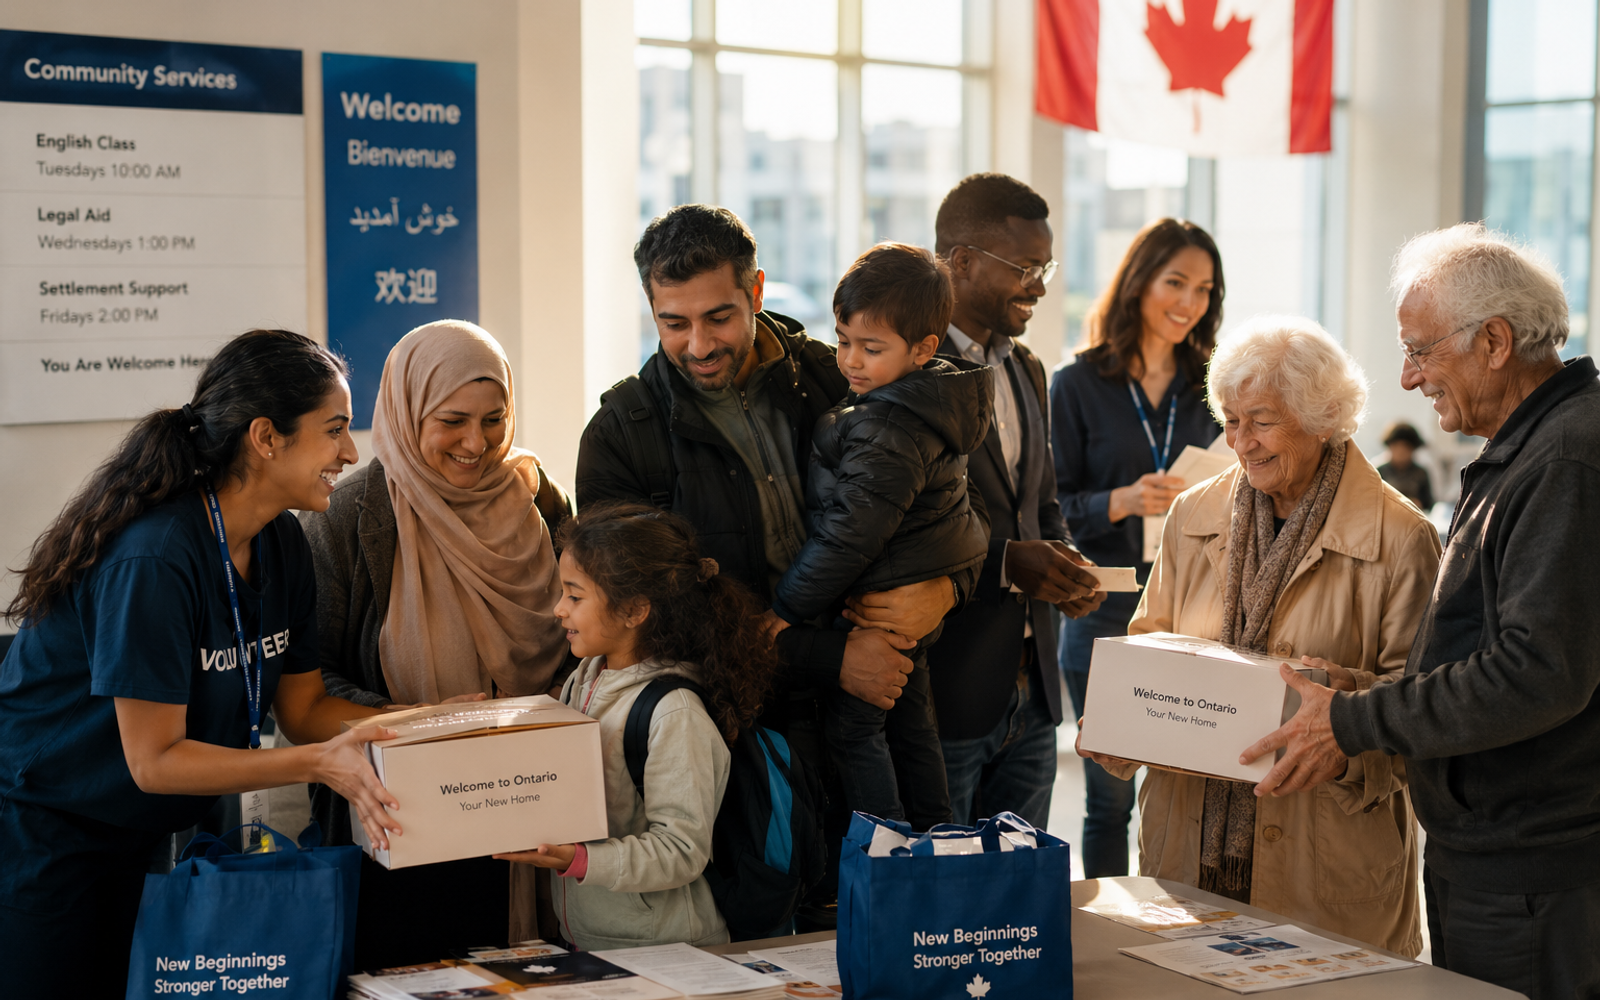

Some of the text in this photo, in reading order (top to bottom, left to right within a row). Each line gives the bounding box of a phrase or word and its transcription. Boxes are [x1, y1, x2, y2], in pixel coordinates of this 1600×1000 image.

[24, 57, 238, 90] Community Services
[340, 91, 461, 125] Welcome
[36, 133, 136, 153] English Class
[347, 139, 457, 170] Bienvenue
[36, 160, 181, 181] Tuesdays 10:00 AM
[37, 207, 111, 225] Legal Aid
[405, 203, 459, 235] خوش
[37, 234, 195, 254] Wednesdays 1:00 PM
[39, 280, 188, 298] Settlement Support
[375, 268, 438, 304] 欢迎
[40, 307, 158, 327] Fridays 2:00 PM
[40, 358, 70, 373] You
[75, 358, 103, 371] Are
[106, 356, 176, 371] Welcome
[1133, 686, 1237, 715] Welcome to Ontario
[1145, 707, 1217, 729] Your New Home
[439, 770, 558, 796] Welcome to Ontario
[459, 793, 541, 812] Your New Home
[913, 924, 1038, 947] New Beginnings
[156, 952, 287, 973] New Beginnings
[913, 945, 1042, 970] Stronger Together
[154, 974, 290, 997] Stronger Together
